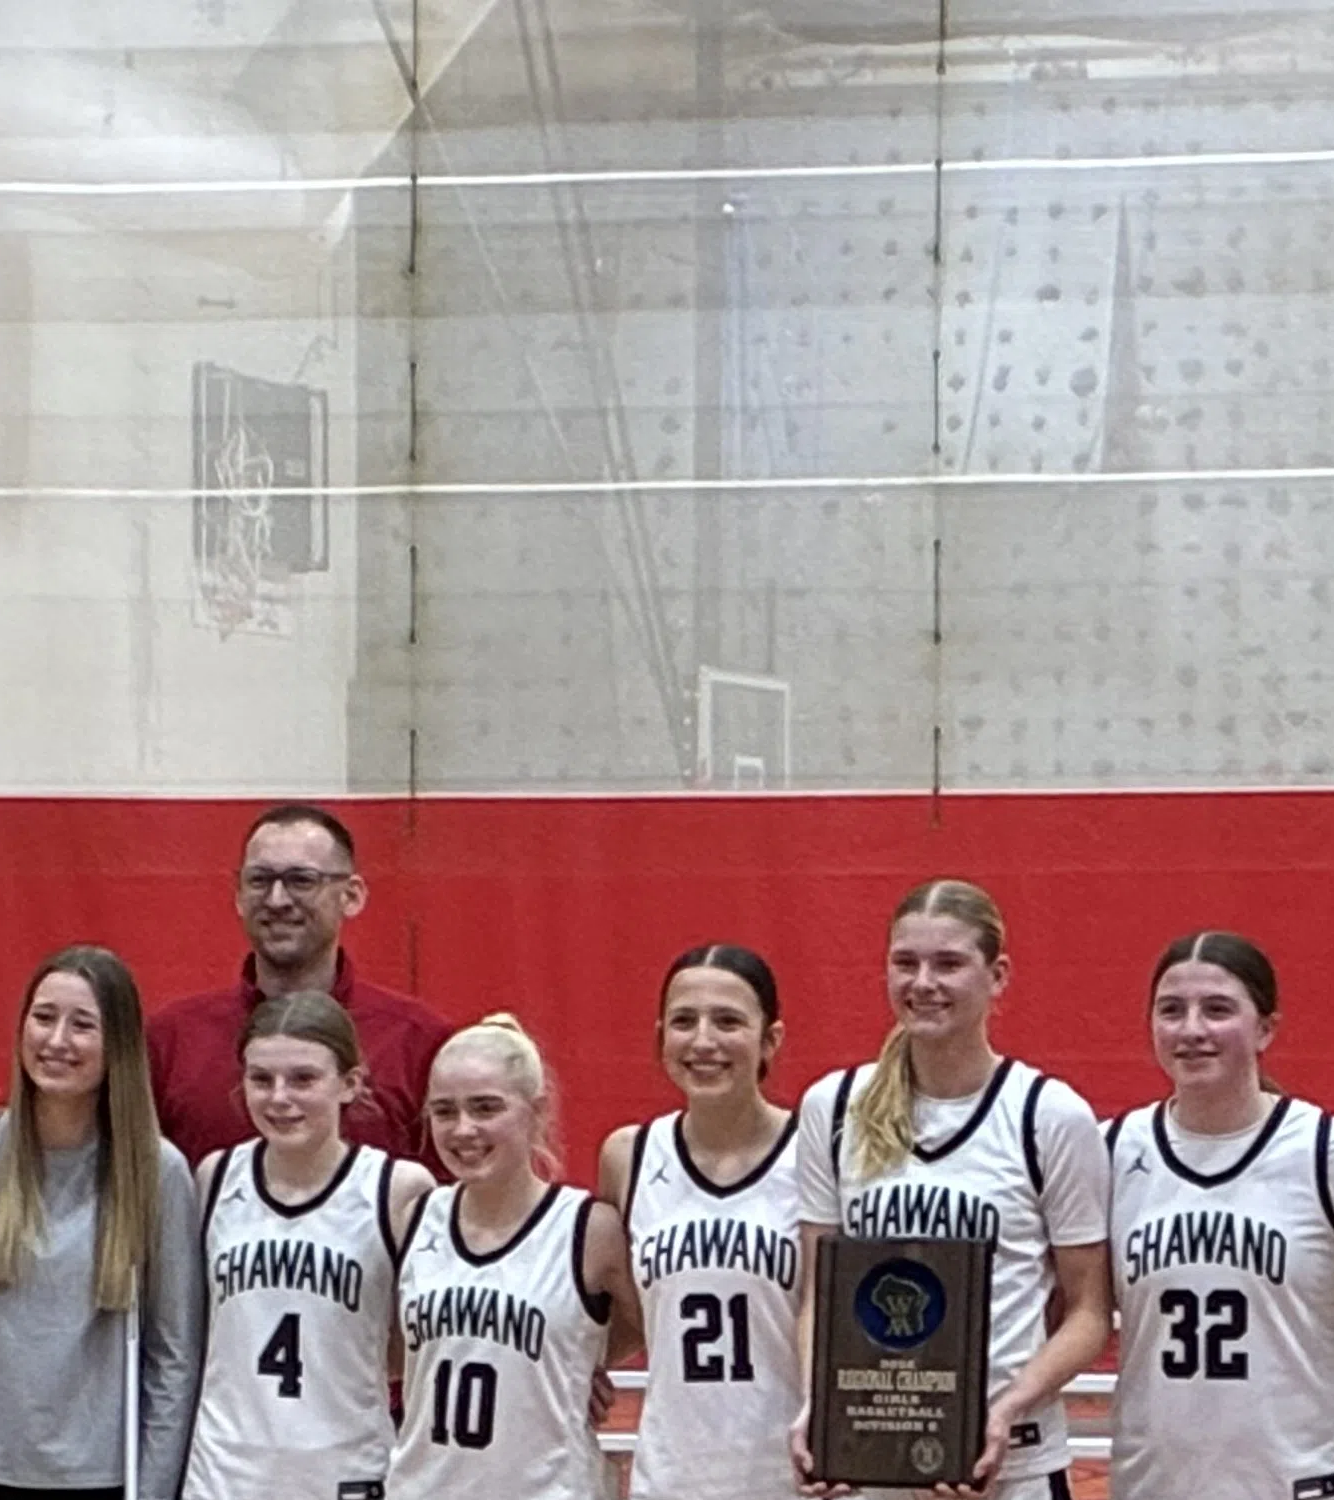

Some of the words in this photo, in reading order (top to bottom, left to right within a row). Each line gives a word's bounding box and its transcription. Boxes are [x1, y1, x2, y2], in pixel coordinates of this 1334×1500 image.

[214, 1239, 364, 1313] SHAWANO
[640, 1219, 798, 1291] SHAWANO
[1127, 1211, 1287, 1286] SHAWANO
[257, 1312, 303, 1398] 4
[406, 1286, 546, 1362] SHAWANO
[680, 1293, 755, 1383] 21
[1160, 1288, 1249, 1380] 32
[431, 1358, 498, 1449] 10
[846, 1405, 945, 1418] BASKETBALL
[852, 1420, 924, 1432] DIVISION
[872, 1393, 921, 1404] GIRLS
